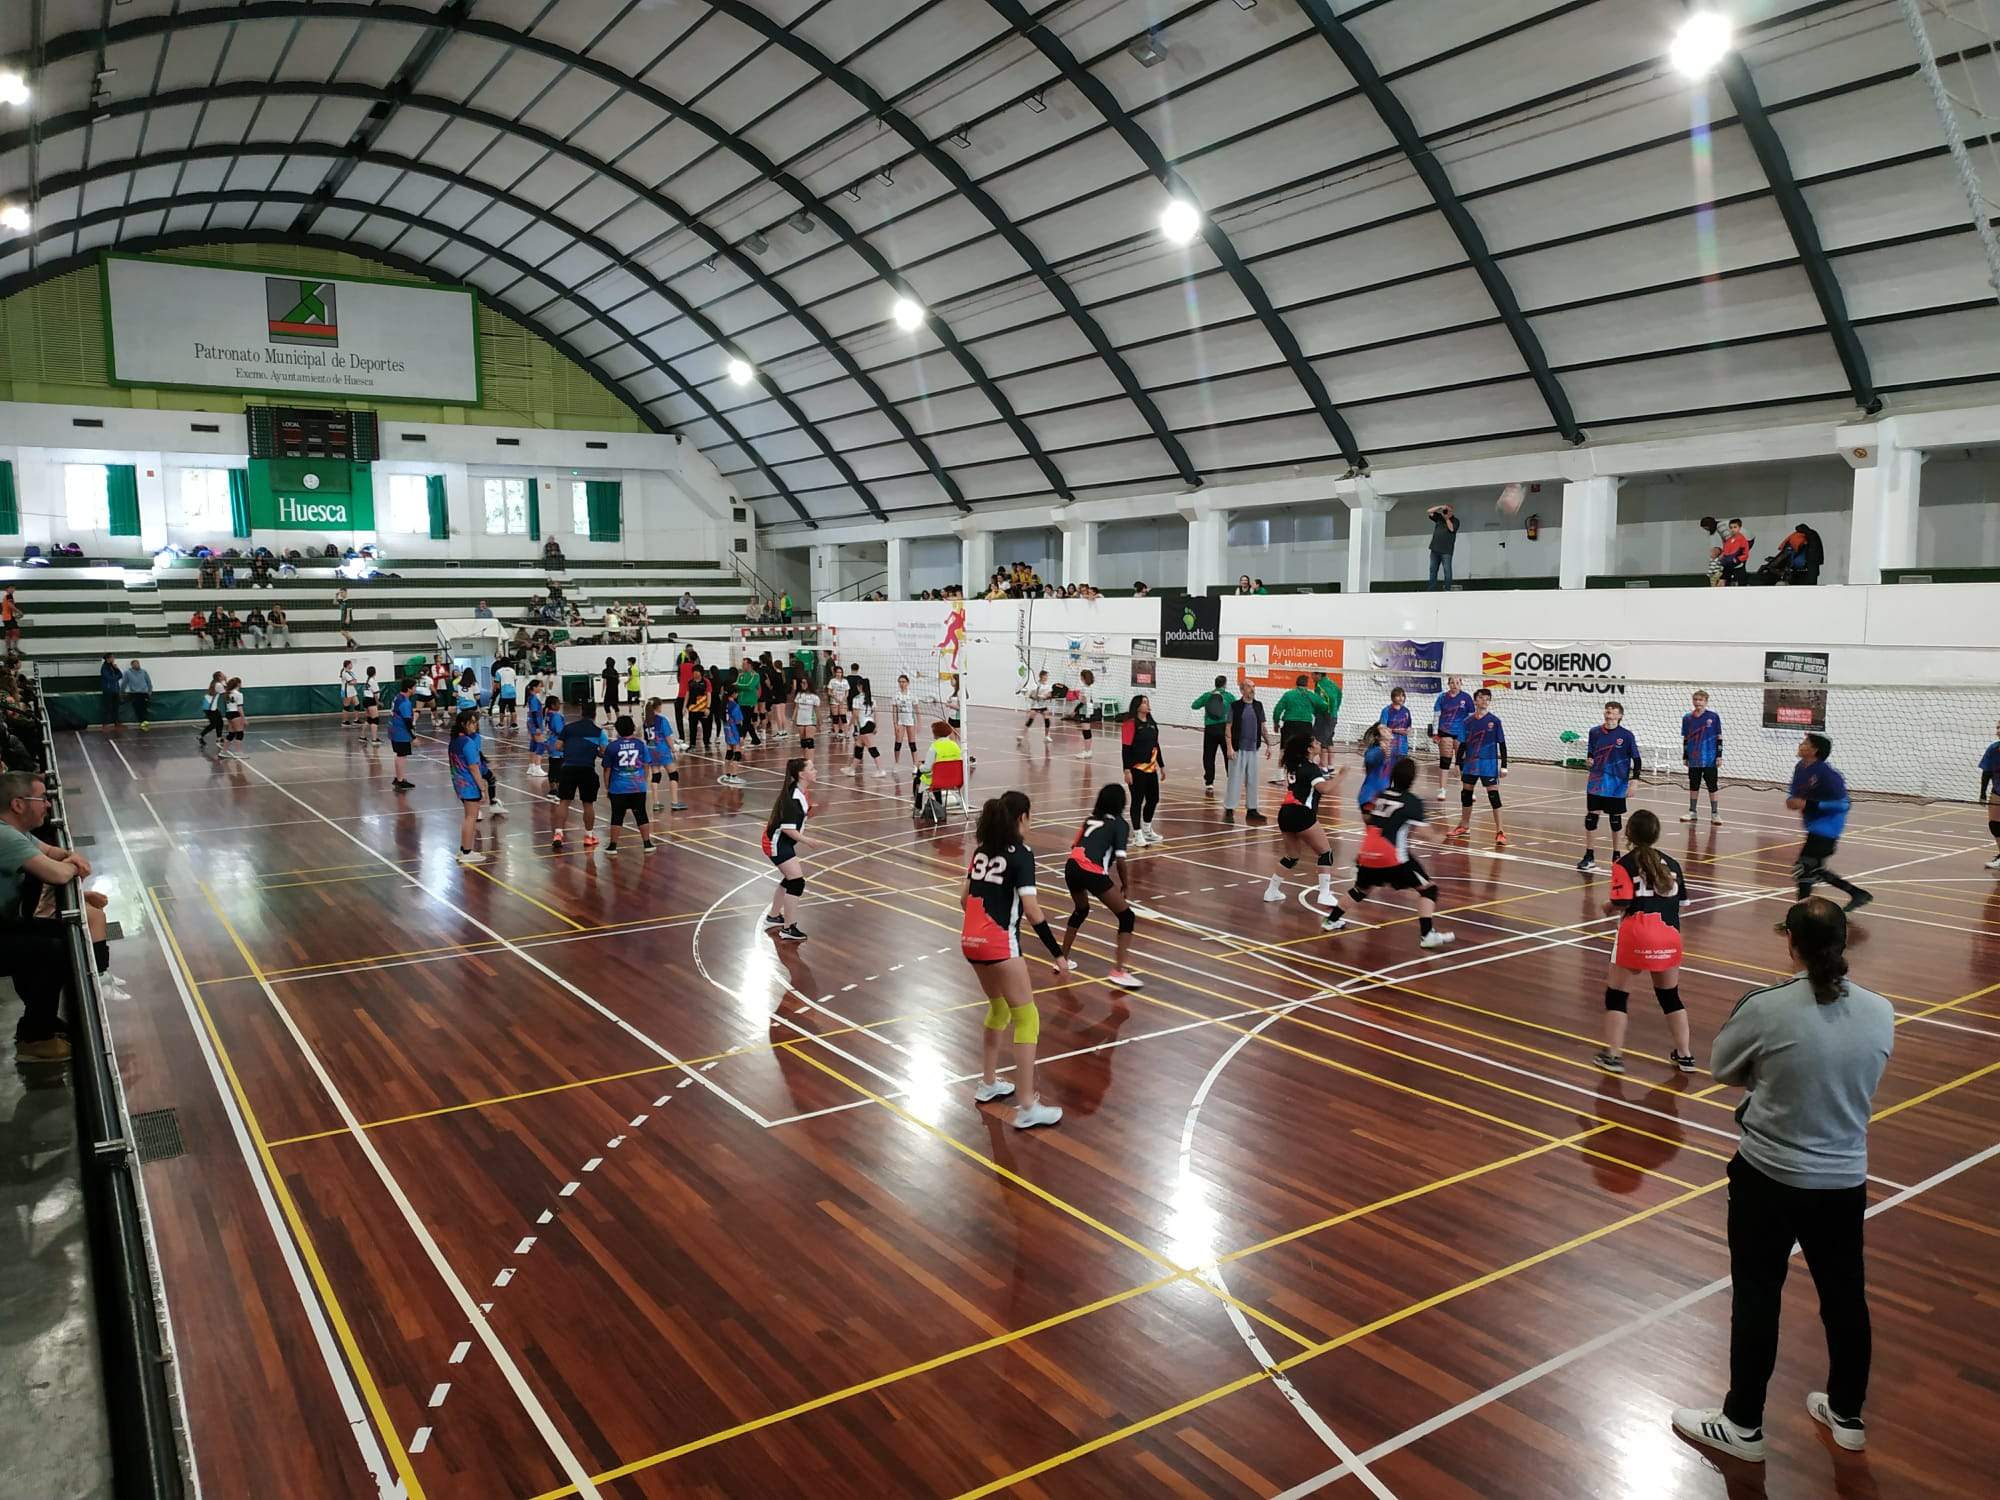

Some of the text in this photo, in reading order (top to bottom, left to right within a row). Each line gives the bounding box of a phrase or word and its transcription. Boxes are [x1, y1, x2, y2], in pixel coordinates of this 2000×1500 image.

[194, 343, 405, 373] Patronato Municipal de Deportes
[269, 370, 332, 383] Ayuntamiento
[332, 374, 343, 384] de
[343, 375, 374, 386] Huesca
[278, 497, 348, 523] Huesca
[1165, 628, 1215, 645] podoactiva
[1271, 644, 1334, 659] Ayuntamiento
[1514, 652, 1612, 672] GOBIERNO
[1514, 673, 1538, 690] DE
[618, 749, 639, 767] 27
[1084, 819, 1105, 838] 7
[971, 852, 1007, 885] 32
